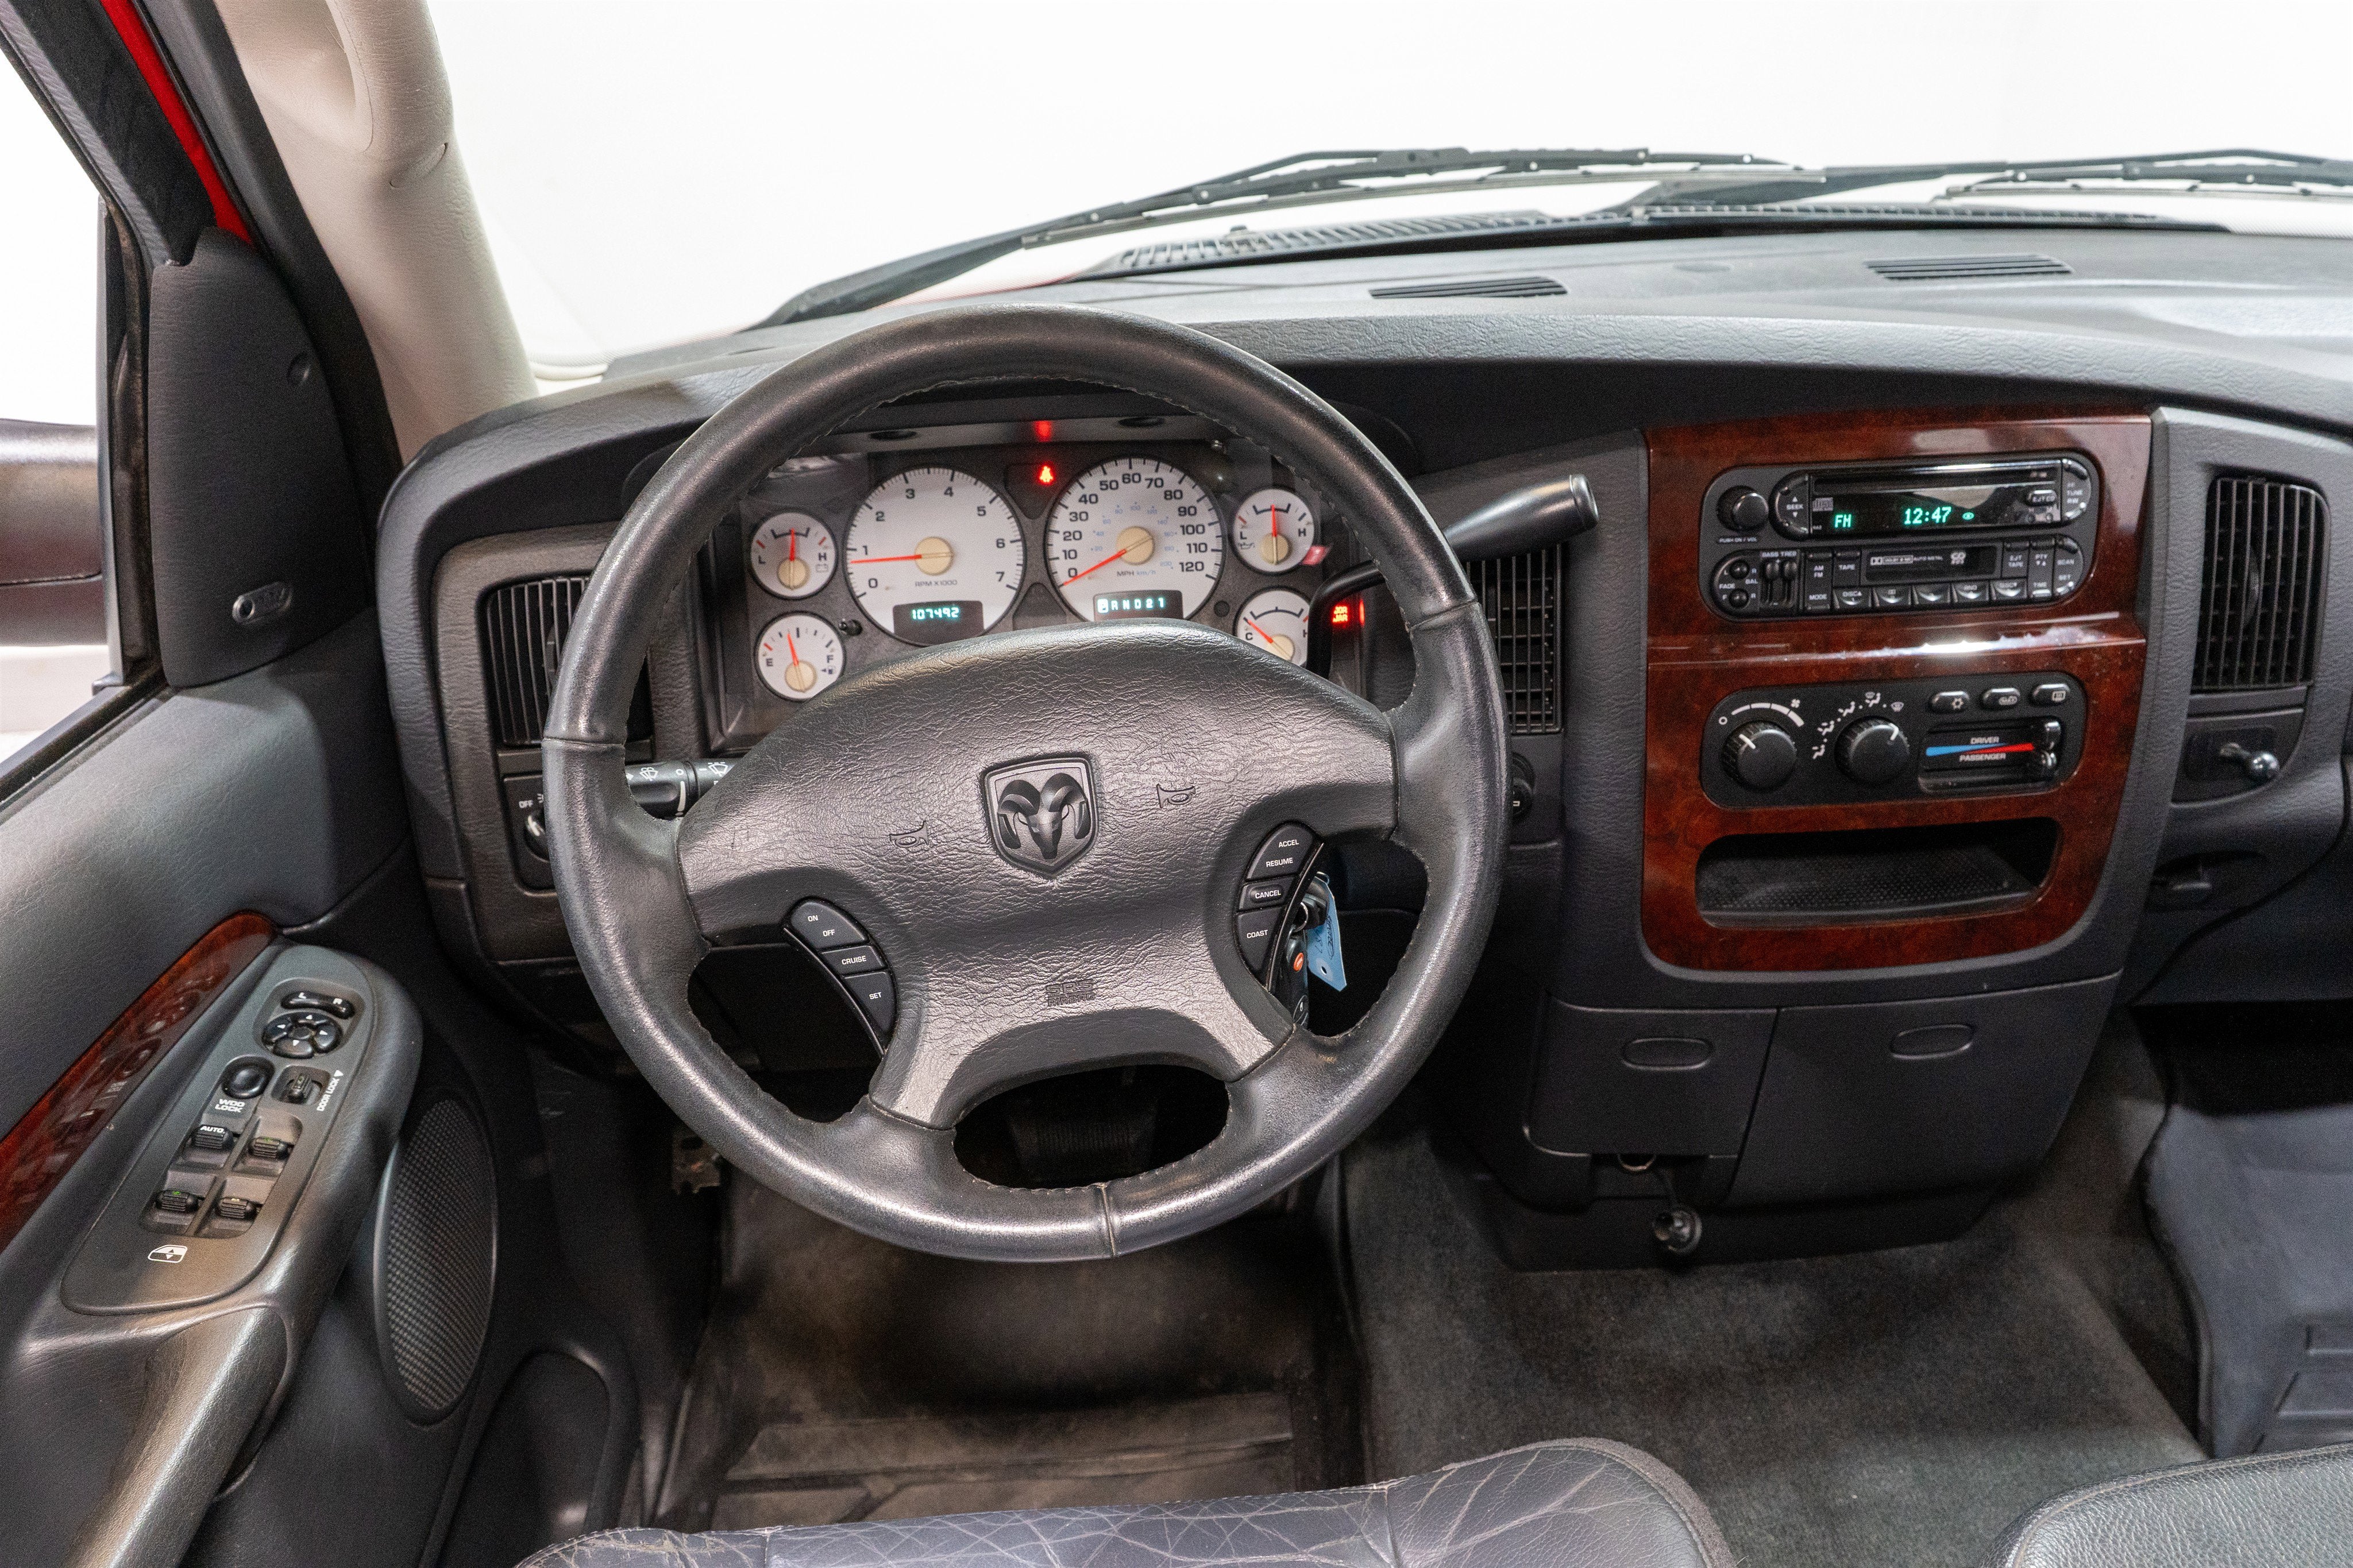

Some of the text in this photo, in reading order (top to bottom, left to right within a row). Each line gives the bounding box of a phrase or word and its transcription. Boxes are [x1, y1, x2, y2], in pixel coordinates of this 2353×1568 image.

[1122, 473, 1141, 484] 60
[1145, 477, 1164, 488] 70
[1100, 480, 1118, 491] 50
[906, 489, 915, 499] 3
[944, 486, 953, 497] 4
[1164, 490, 1183, 501] 80
[1079, 494, 1098, 505] 40
[876, 511, 885, 522] 2
[977, 507, 986, 516] 5
[1178, 506, 1197, 517] 90
[1904, 507, 1951, 525] 12:47
[1070, 512, 1089, 522] 30
[1180, 524, 1205, 535] 100
[1063, 531, 1082, 541] 20
[996, 538, 1005, 549] 6
[1187, 543, 1208, 553] 110
[863, 546, 868, 555] 1
[1064, 549, 1077, 559] 10
[758, 555, 765, 564] L
[819, 553, 827, 561] H
[1179, 561, 1205, 572] 120
[996, 572, 1005, 581] 7
[1068, 567, 1078, 578] 0
[869, 578, 878, 588] 0
[1111, 600, 1118, 610] R
[1123, 600, 1130, 610] N
[1146, 598, 1153, 608] 2
[912, 607, 959, 620] 107492
[766, 658, 773, 666] E
[827, 655, 833, 664] F
[1970, 736, 1999, 744] DRIVER
[1959, 754, 2006, 762] PASSENGER
[519, 800, 533, 808] OFF
[1278, 839, 1299, 848] ACCEL
[1266, 858, 1293, 868] RESUME
[1255, 890, 1281, 899] CANCEL
[1247, 929, 1268, 939] COAST
[841, 955, 867, 965] CRUISE
[1046, 979, 1094, 995] SRS
[869, 992, 882, 1000] SET
[1047, 992, 1096, 1007] AIRBAG
[317, 1077, 341, 1112] DOOR LOCK
[214, 1104, 243, 1113] LOCK
[219, 1099, 245, 1108] WDO
